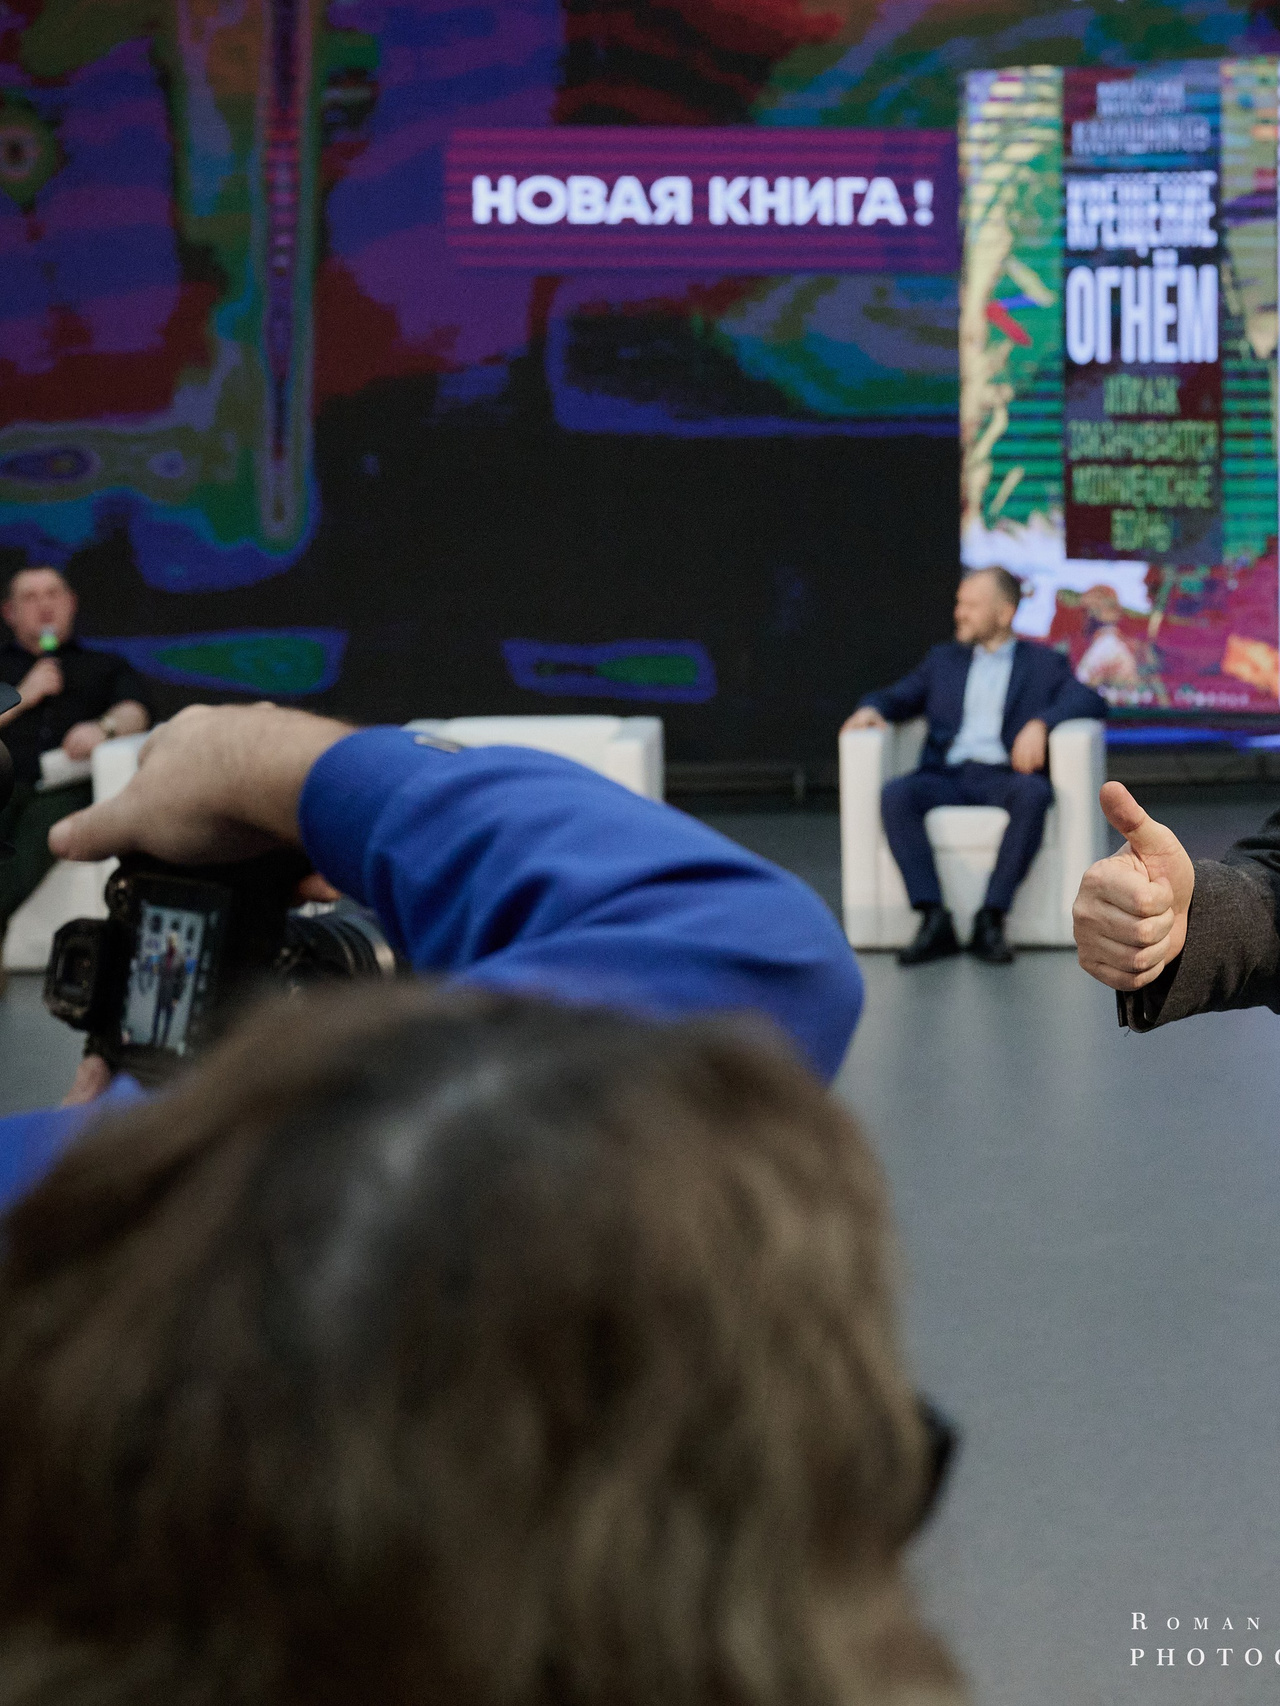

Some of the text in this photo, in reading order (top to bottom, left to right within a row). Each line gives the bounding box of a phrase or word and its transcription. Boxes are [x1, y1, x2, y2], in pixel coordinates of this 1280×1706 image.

[472, 175, 934, 226] НОВАЯ КНИГА!
[1066, 249, 1219, 365] ОГНЁМ
